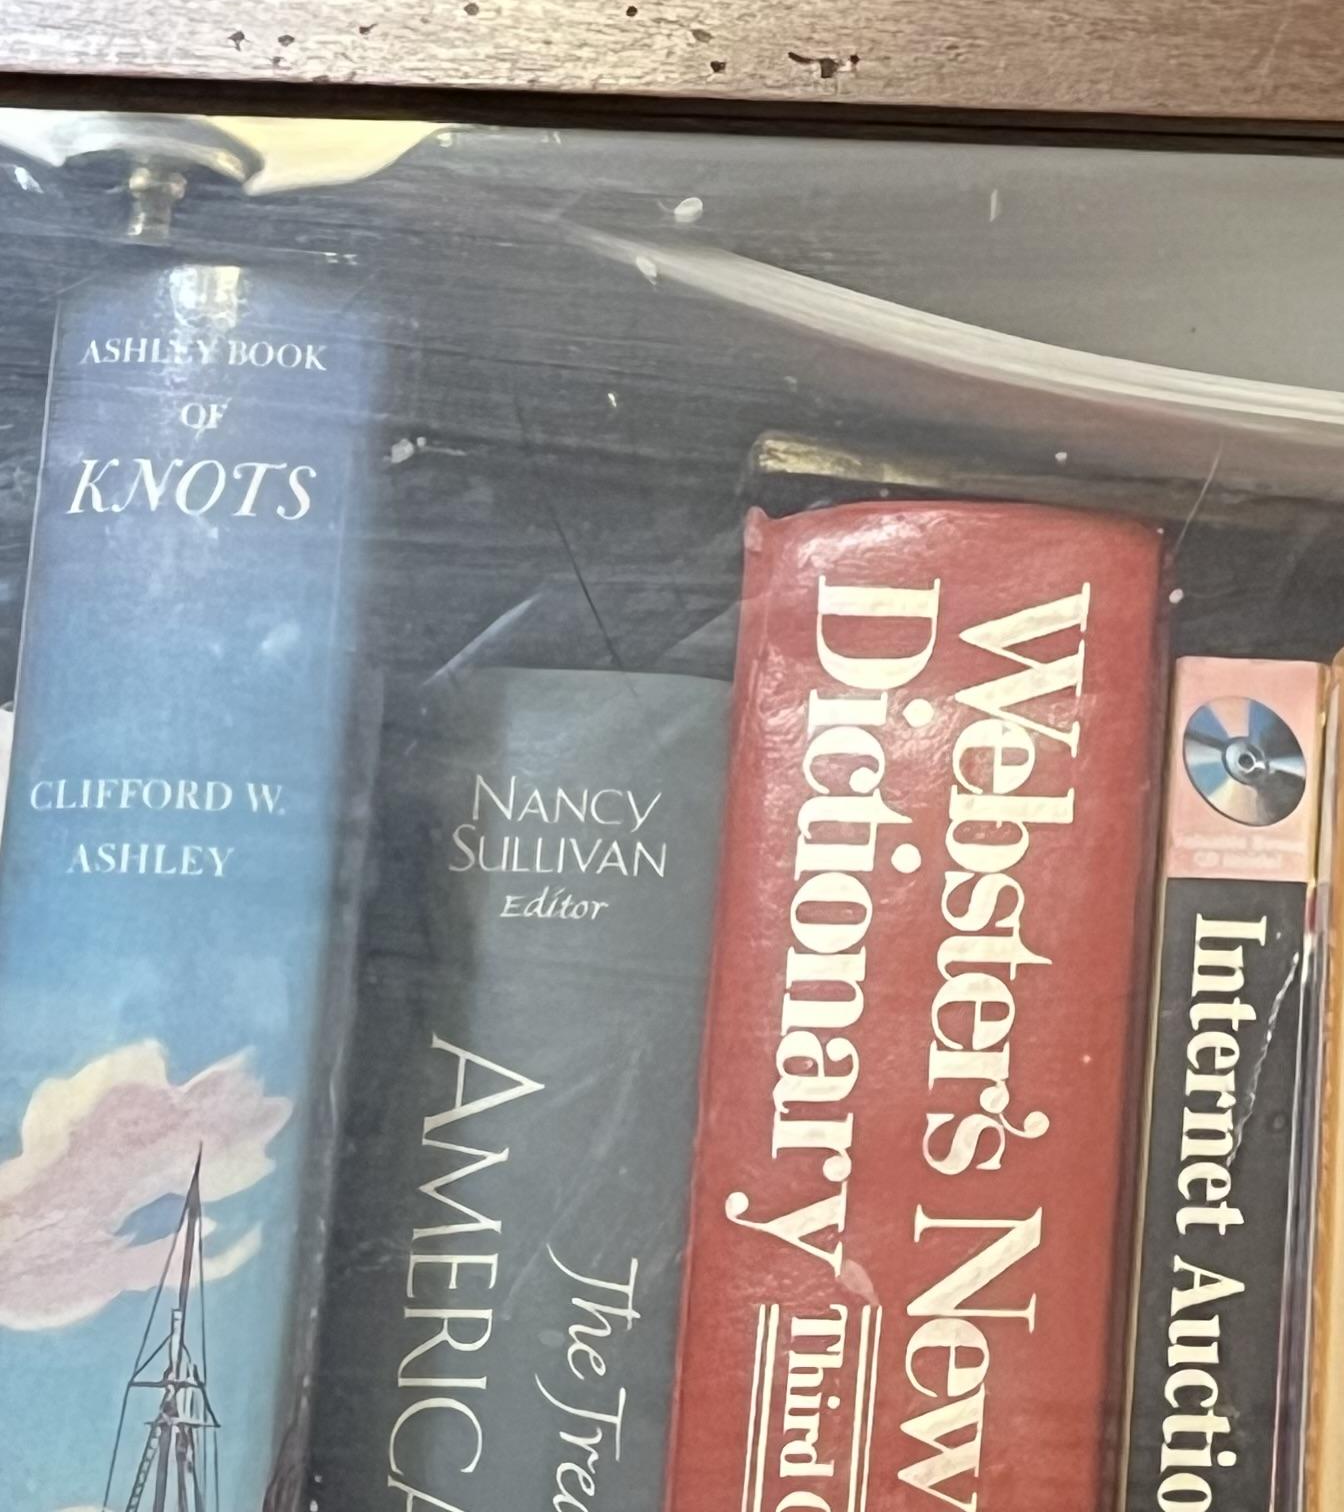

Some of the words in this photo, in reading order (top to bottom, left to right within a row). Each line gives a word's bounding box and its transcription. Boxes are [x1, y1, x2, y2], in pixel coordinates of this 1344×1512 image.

[80, 337, 220, 366] ASHLEY
[227, 339, 327, 371] BOOK
[180, 400, 229, 430] OF
[67, 457, 317, 520] KNOTS
[29, 779, 233, 813] CLIFFORD
[247, 782, 286, 816] W.
[472, 774, 662, 831] NANCY
[67, 843, 235, 876] ASHLEY
[449, 825, 668, 879] SULLIVAN
[922, 581, 1092, 1177] Webster's
[499, 885, 610, 922] Editor
[724, 575, 941, 1278] Dictionary
[1175, 913, 1267, 1237] Internet
[545, 1242, 640, 1380] The
[896, 1202, 1043, 1512] New
[777, 1304, 850, 1479] Third
